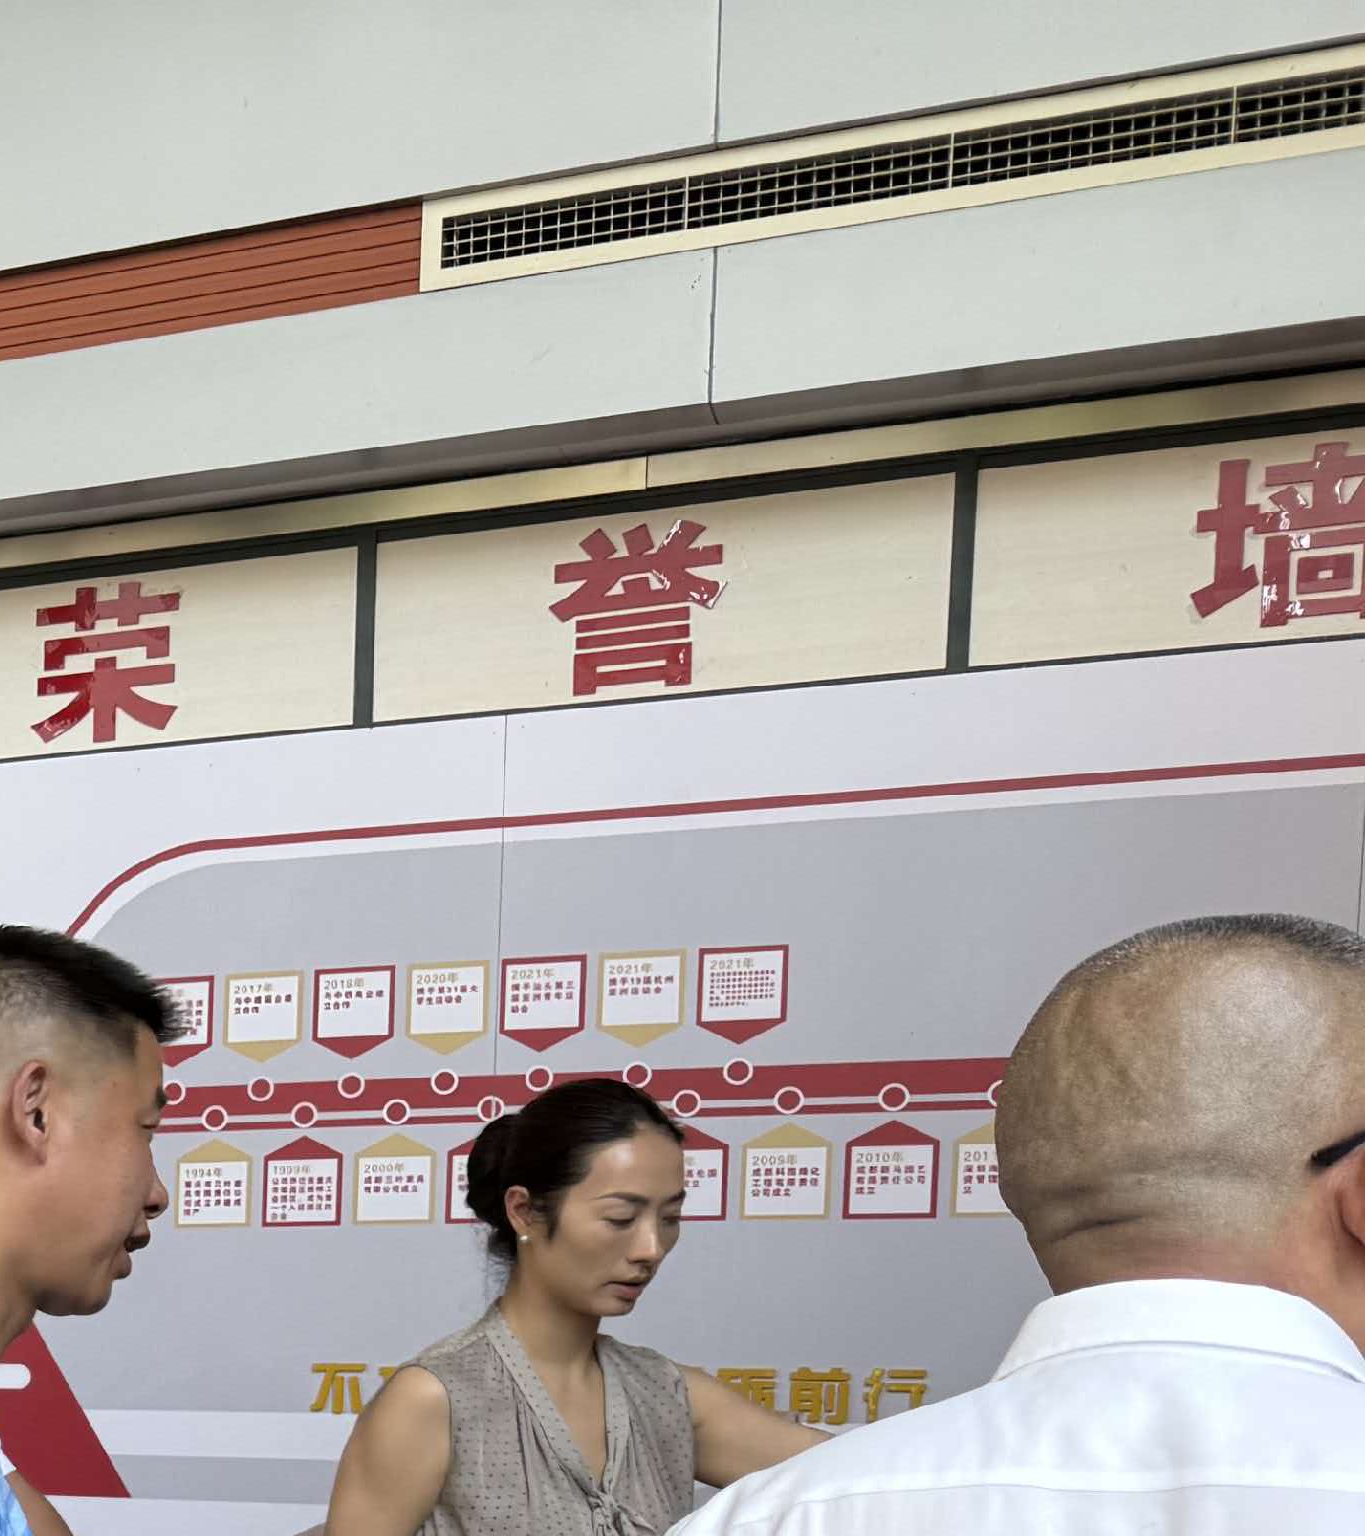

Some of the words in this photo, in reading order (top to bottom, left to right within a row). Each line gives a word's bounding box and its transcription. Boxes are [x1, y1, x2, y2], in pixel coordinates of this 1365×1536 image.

[31, 582, 182, 744] 荣
[549, 519, 725, 697] 誉
[1190, 441, 1365, 629] 墙
[608, 962, 654, 975] 2021年
[709, 957, 756, 971] 2021年
[416, 973, 459, 984] 2020年
[511, 968, 556, 980] 2021年
[751, 1154, 798, 1166] 2009年
[855, 1150, 905, 1164] 2010年
[364, 1162, 405, 1174] 2000年
